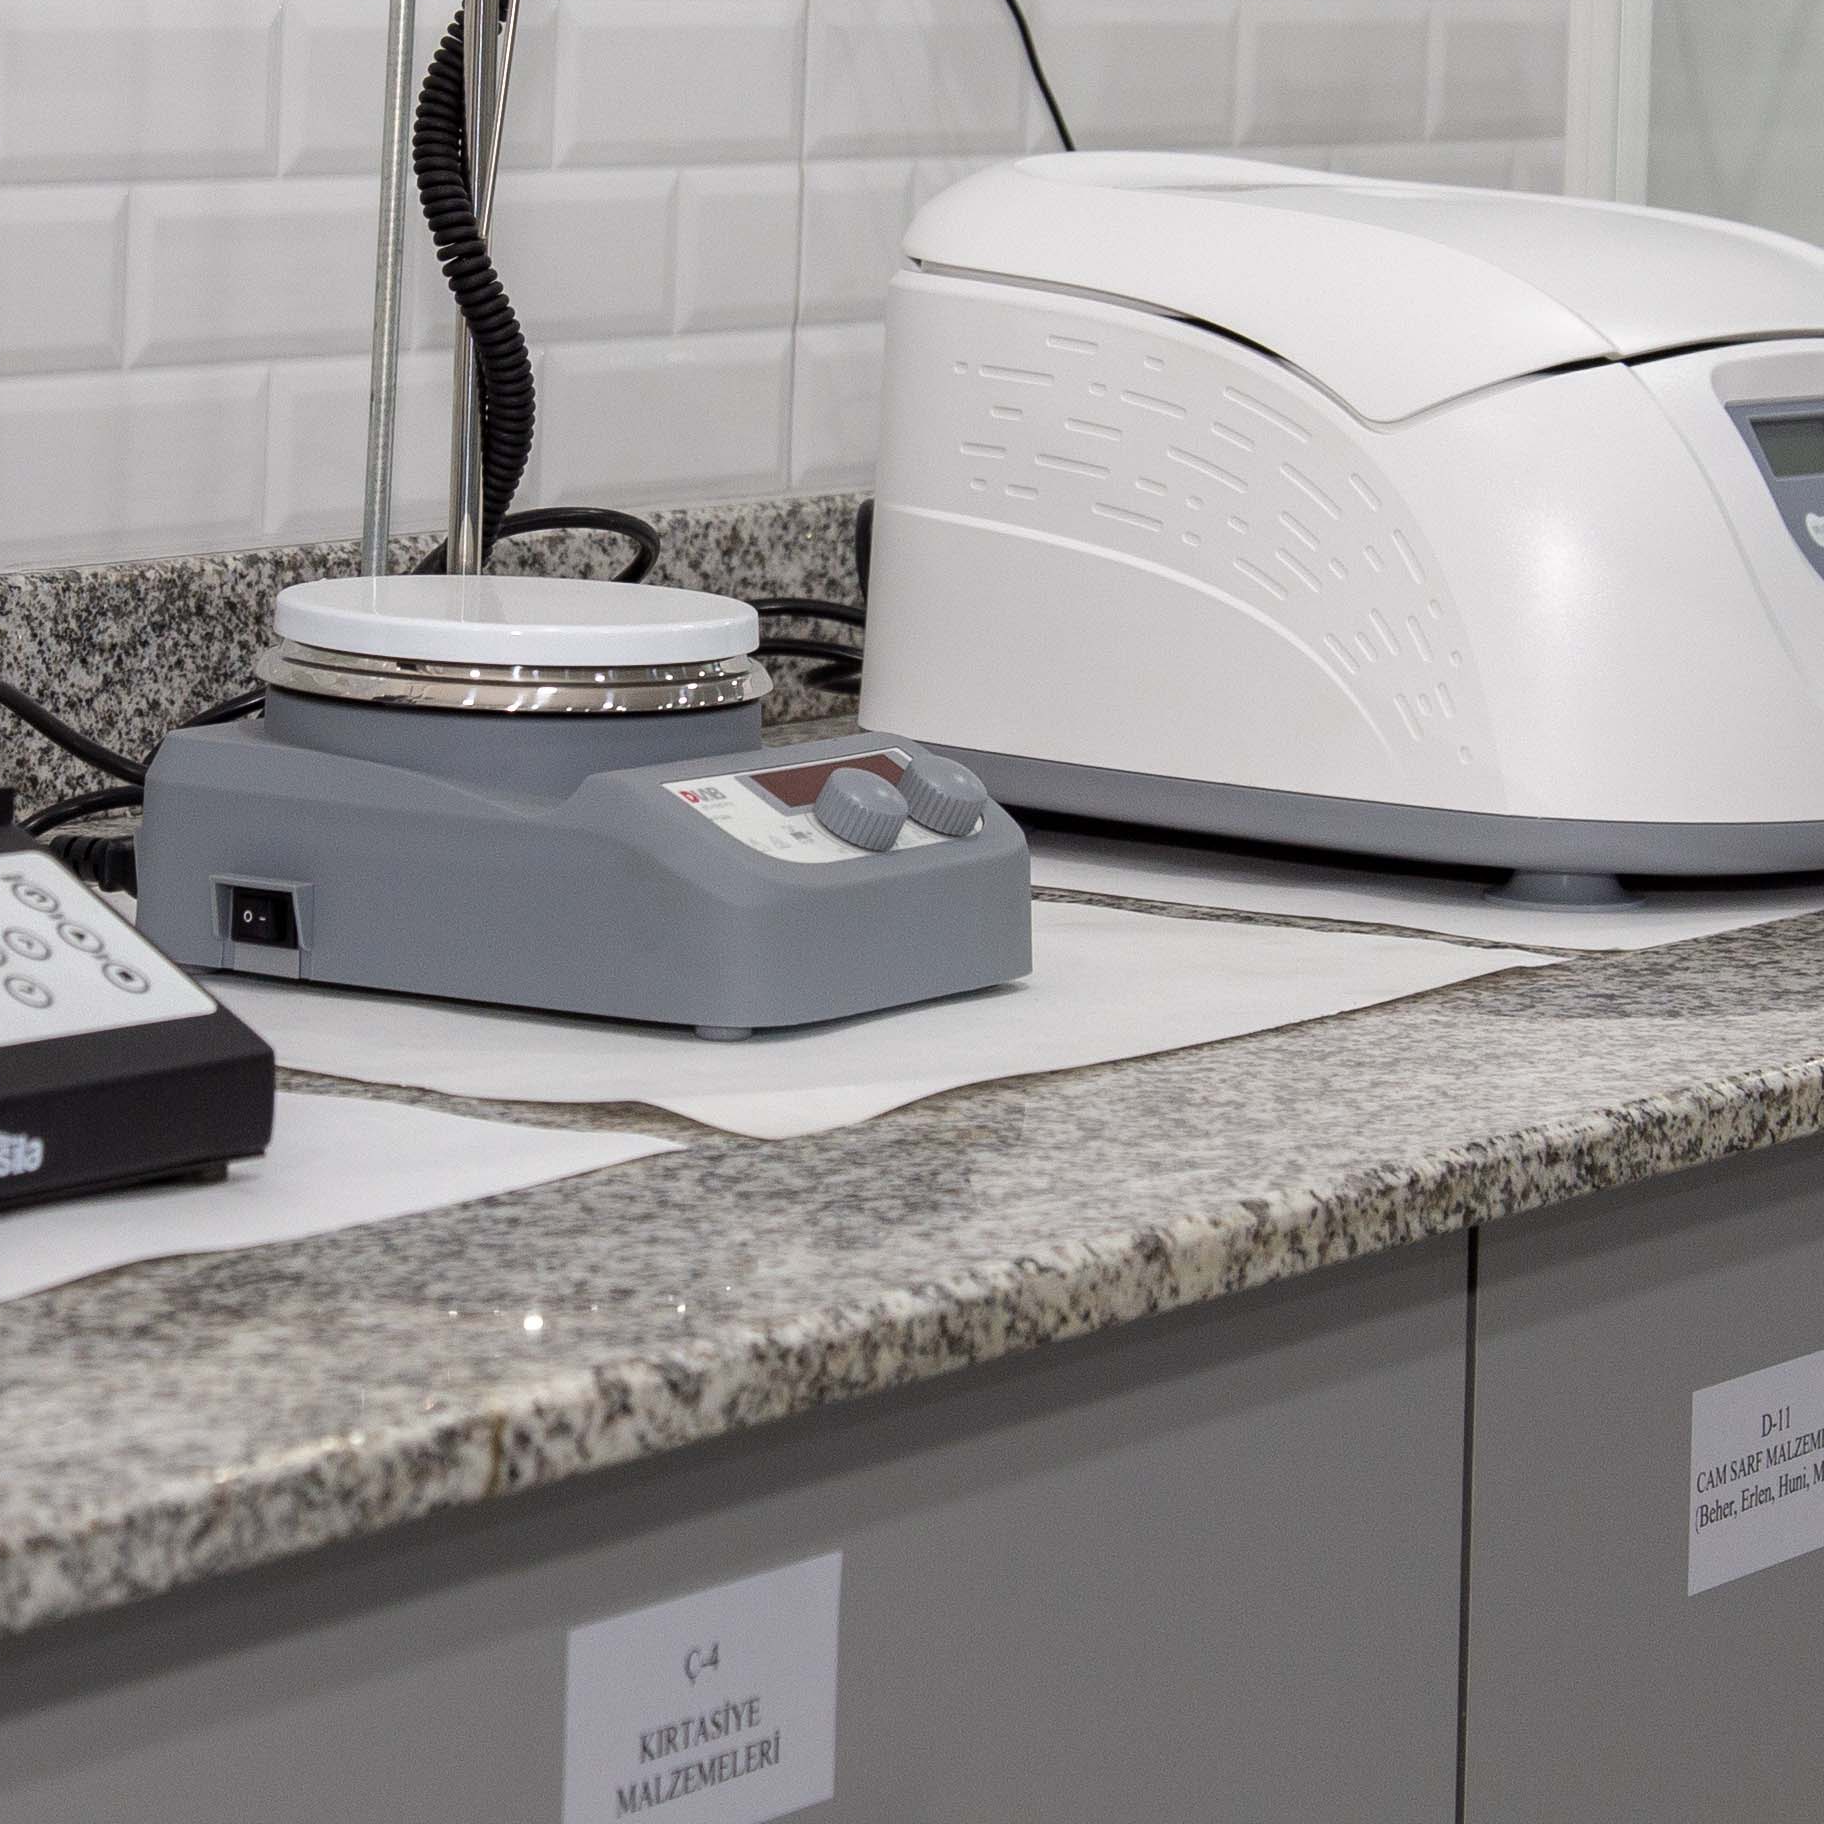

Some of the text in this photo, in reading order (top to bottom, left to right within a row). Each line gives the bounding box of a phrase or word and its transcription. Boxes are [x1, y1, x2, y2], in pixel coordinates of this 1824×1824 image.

[1761, 1405, 1792, 1439] D-11
[1694, 1498, 1738, 1535] (Beher,
[1740, 1483, 1776, 1514] Erlen,
[1778, 1466, 1811, 1498] Huni,
[1696, 1463, 1728, 1495] CAM
[1730, 1449, 1764, 1483] SARF
[682, 1640, 721, 1688] Ç-4
[639, 1695, 763, 1765] KIRTASİYE
[615, 1728, 782, 1819] MALZEMELERİ
